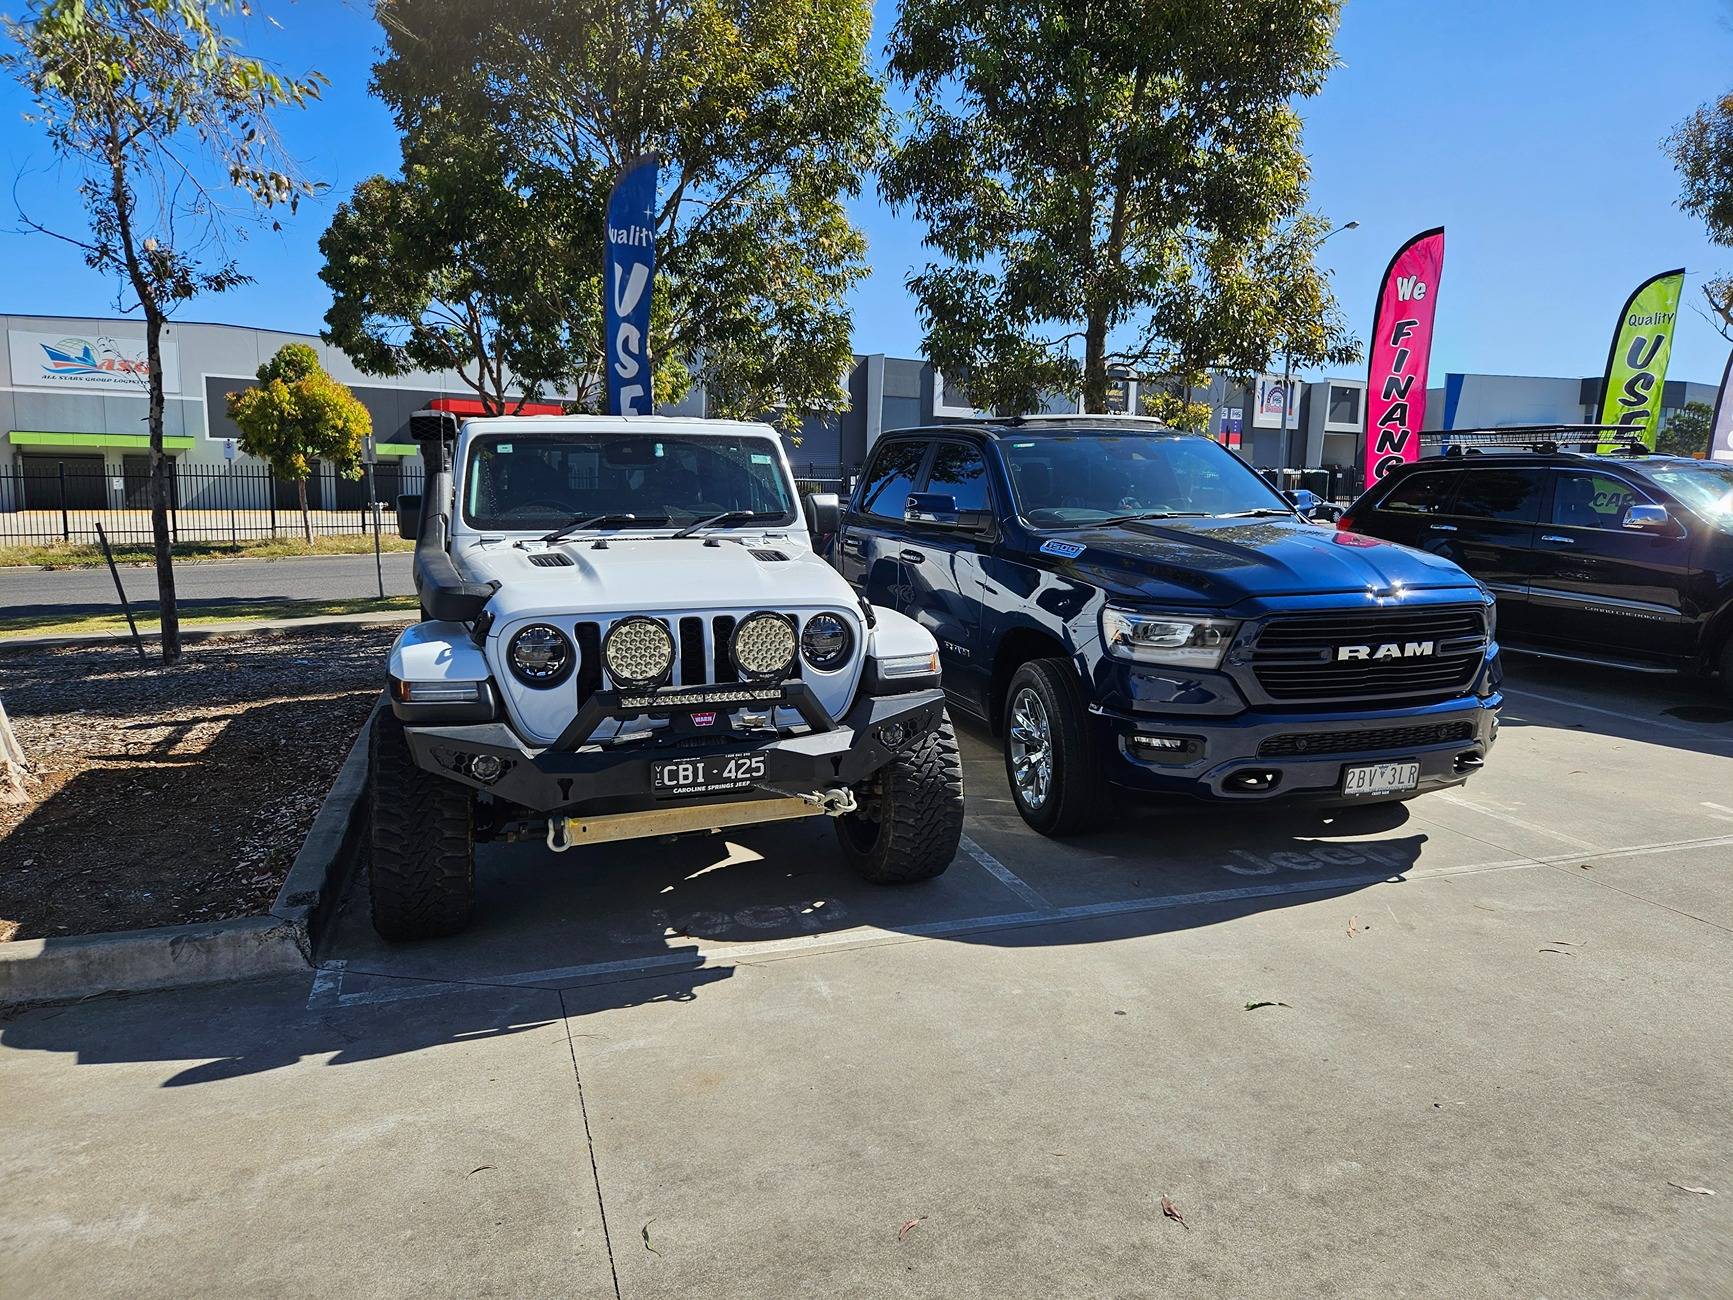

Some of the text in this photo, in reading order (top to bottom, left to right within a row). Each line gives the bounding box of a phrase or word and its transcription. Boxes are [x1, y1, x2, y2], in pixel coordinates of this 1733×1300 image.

[608, 223, 653, 248] ualit
[1396, 275, 1427, 301] We
[1628, 312, 1675, 327] Quality
[1337, 641, 1434, 661] RAM
[663, 756, 765, 786] CBI 425
[1346, 768, 1378, 790] 2BV
[1388, 765, 1418, 786] 3LR
[672, 780, 751, 794] CAROLINE SPRINGS JEEP
[1222, 844, 1409, 876] Jeep
